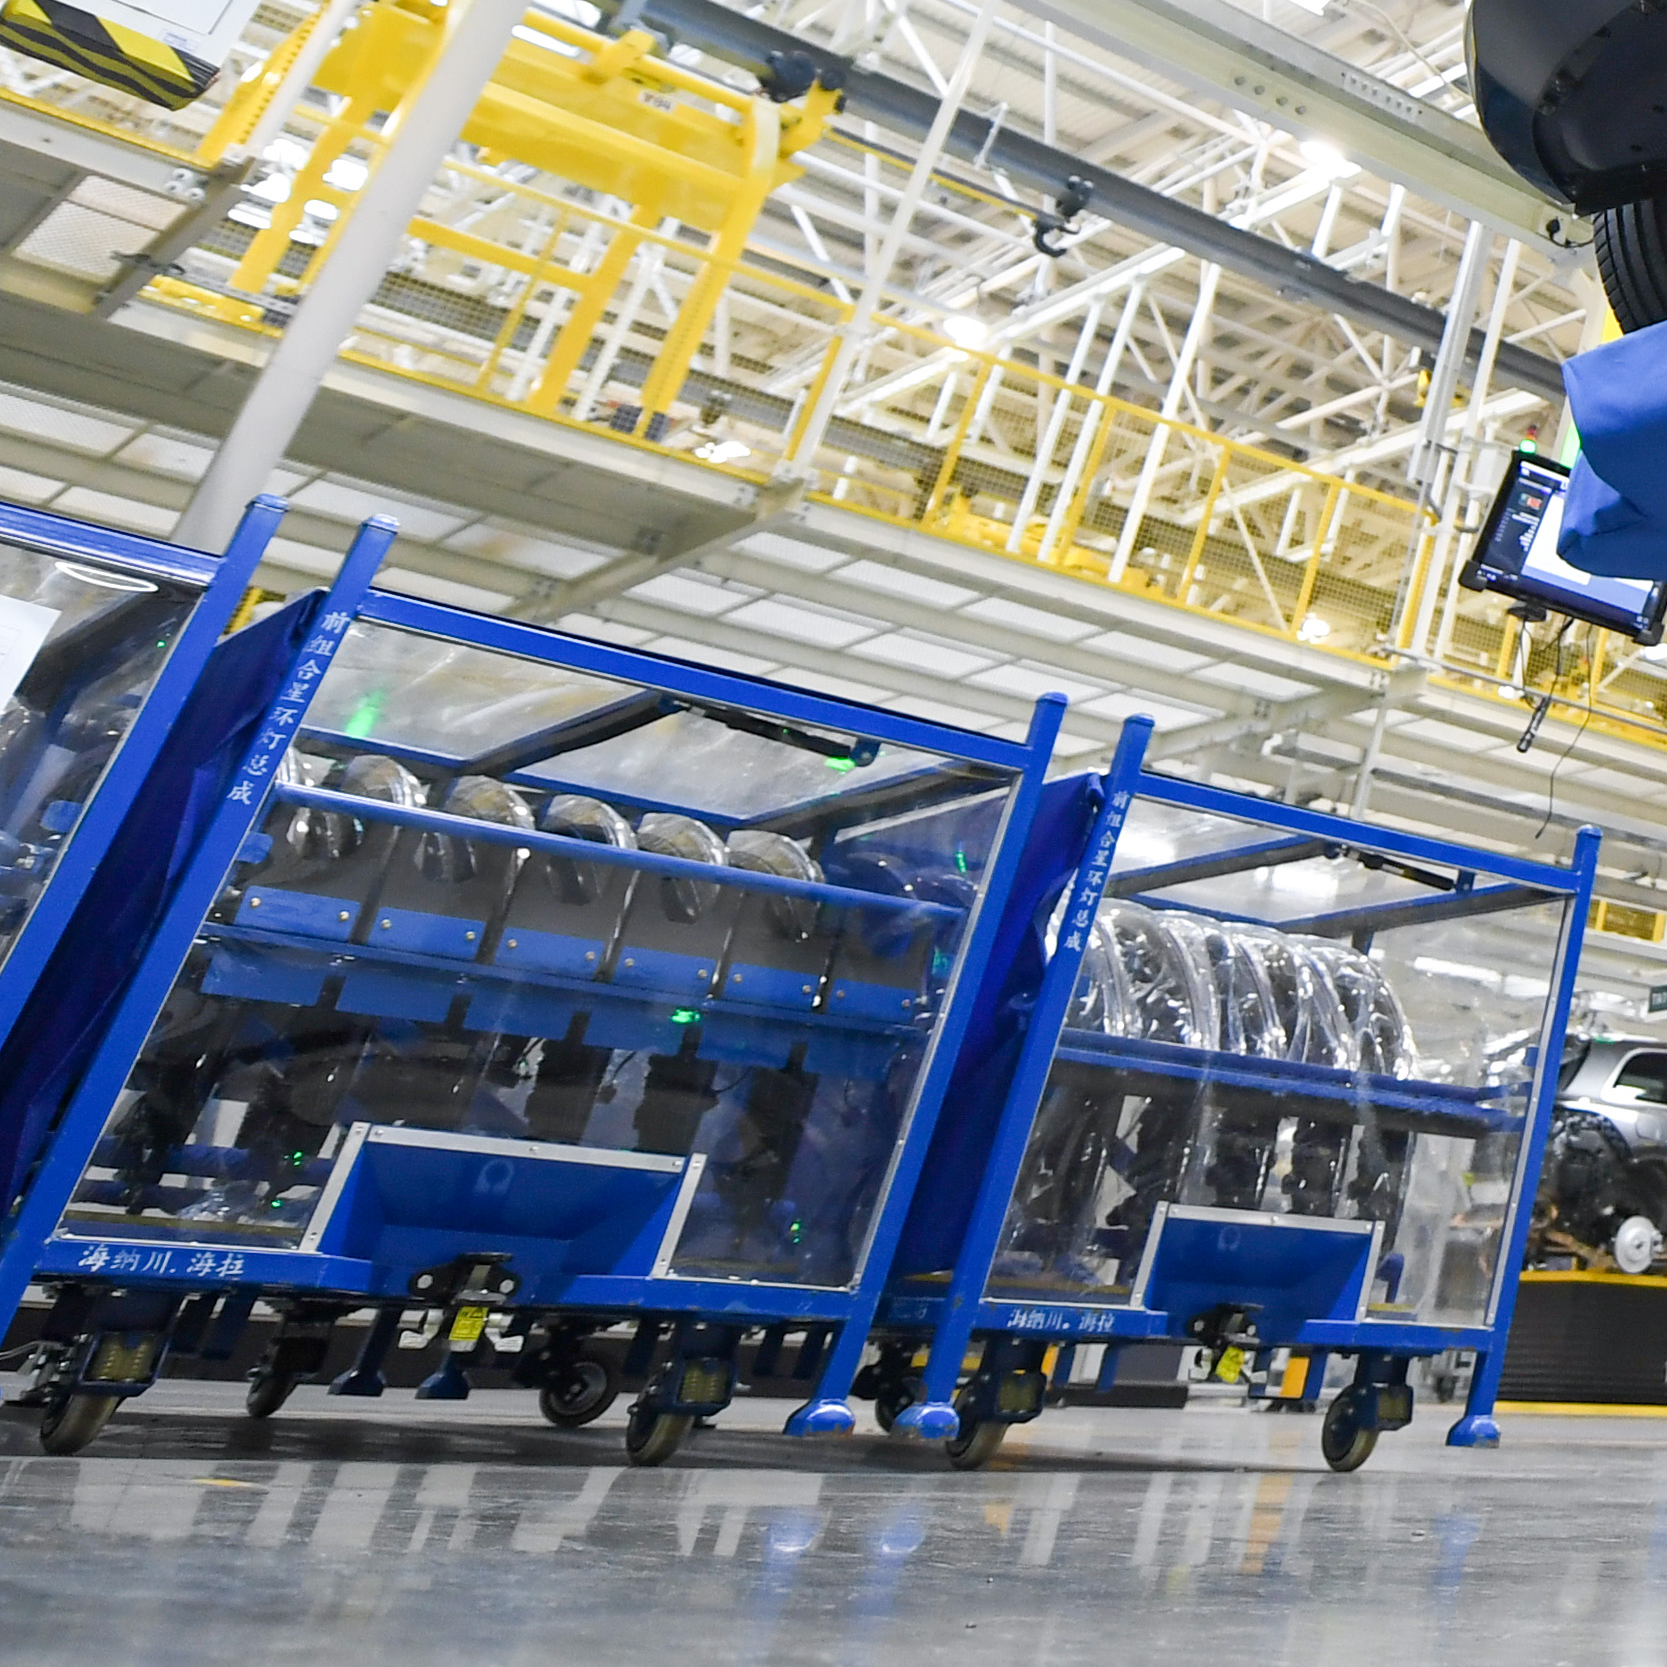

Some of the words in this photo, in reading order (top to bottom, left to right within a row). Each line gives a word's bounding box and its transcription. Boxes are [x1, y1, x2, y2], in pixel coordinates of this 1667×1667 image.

[226, 610, 351, 806] 前组合星环灯总成
